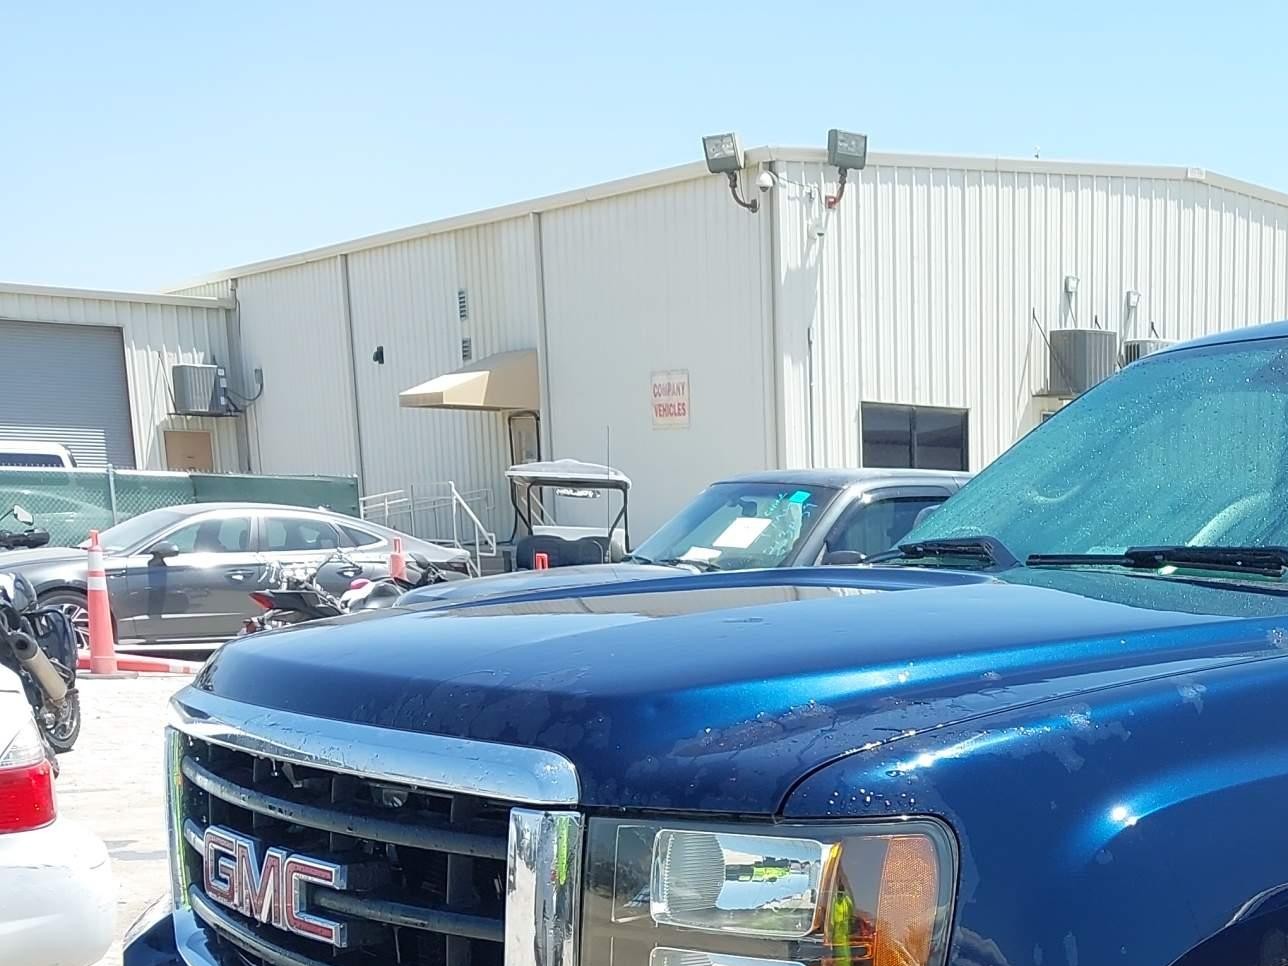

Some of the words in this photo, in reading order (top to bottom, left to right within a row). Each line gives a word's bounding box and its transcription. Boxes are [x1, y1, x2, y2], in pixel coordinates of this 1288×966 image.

[653, 383, 685, 398] COMPANY
[654, 402, 686, 417] VEHICLES
[203, 825, 348, 948] GMC
